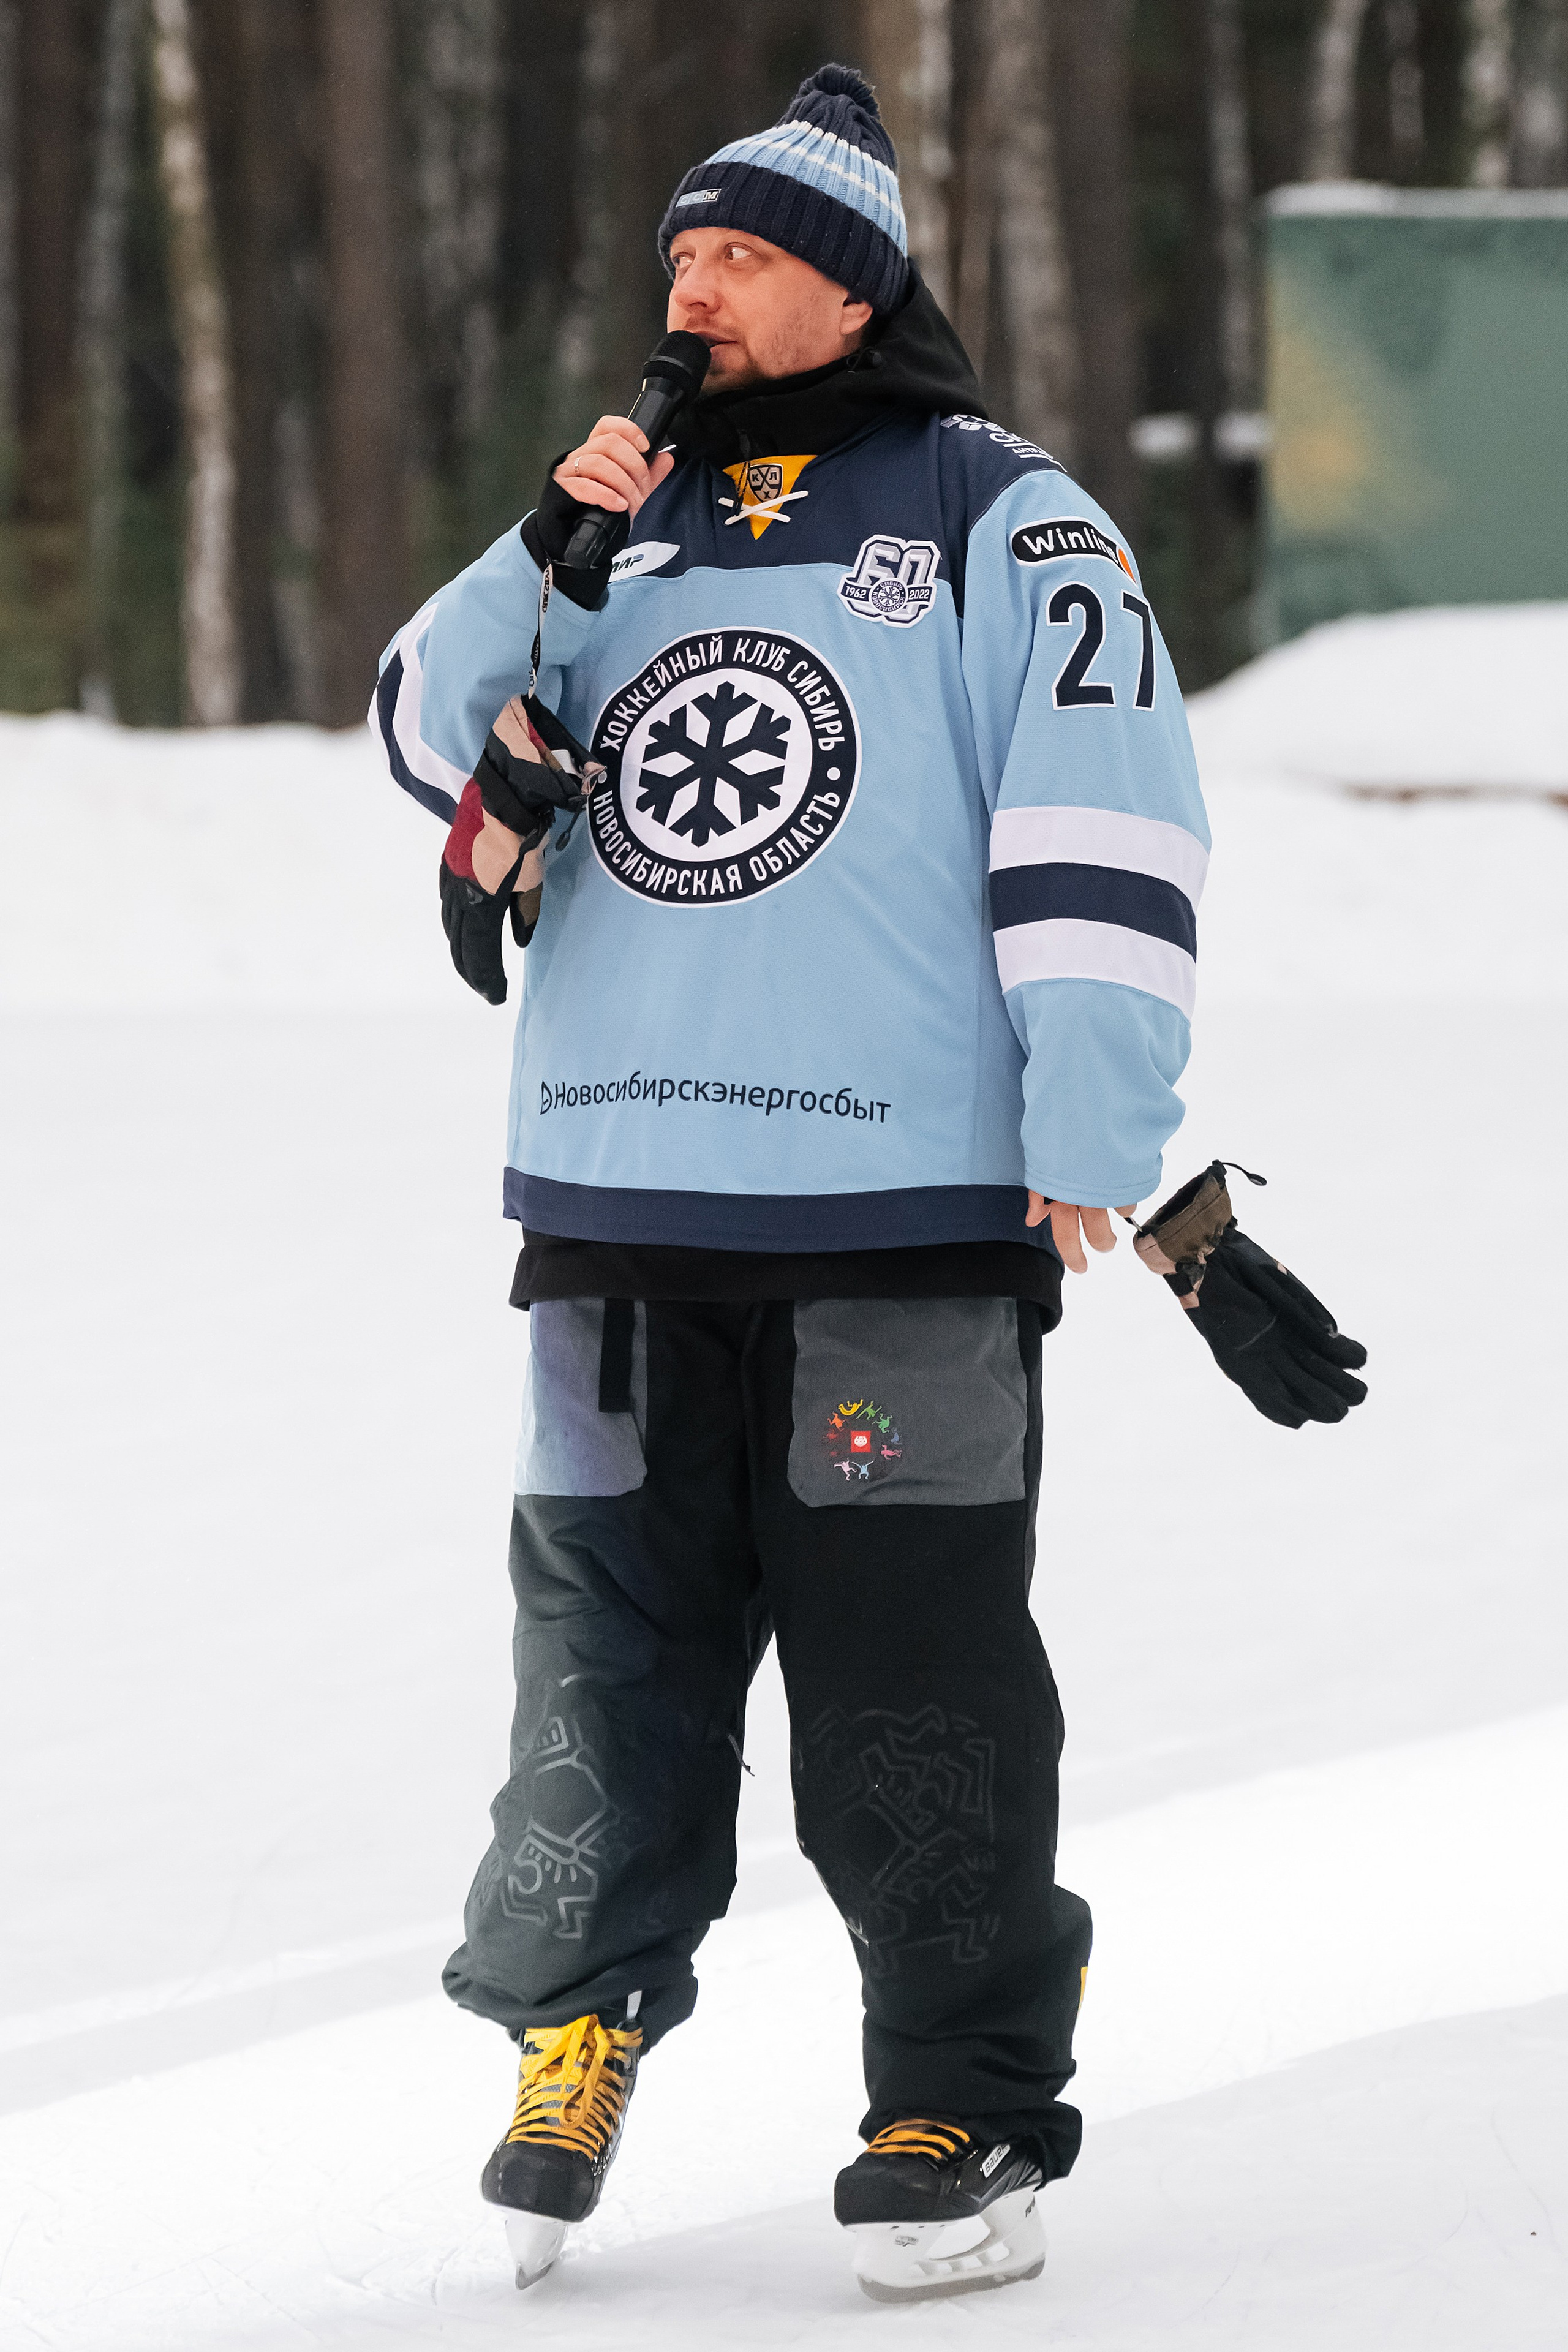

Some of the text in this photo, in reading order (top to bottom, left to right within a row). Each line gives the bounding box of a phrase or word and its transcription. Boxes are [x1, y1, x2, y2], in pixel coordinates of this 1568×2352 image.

[680, 190, 719, 204] CCM
[1022, 527, 1119, 564] Winline
[845, 586, 867, 599] 1962
[908, 589, 930, 600] 2022
[1048, 582, 1155, 710] 27
[600, 635, 723, 752] ХОККЕЙНЫЙ
[733, 638, 791, 673] КЛУБ
[787, 660, 846, 752] СИБИРЬ
[593, 790, 841, 896] НОВОСИБИРСКАЯ ОБЛАСТЬ
[554, 1071, 891, 1123] Новосибирскэнергосбыт
